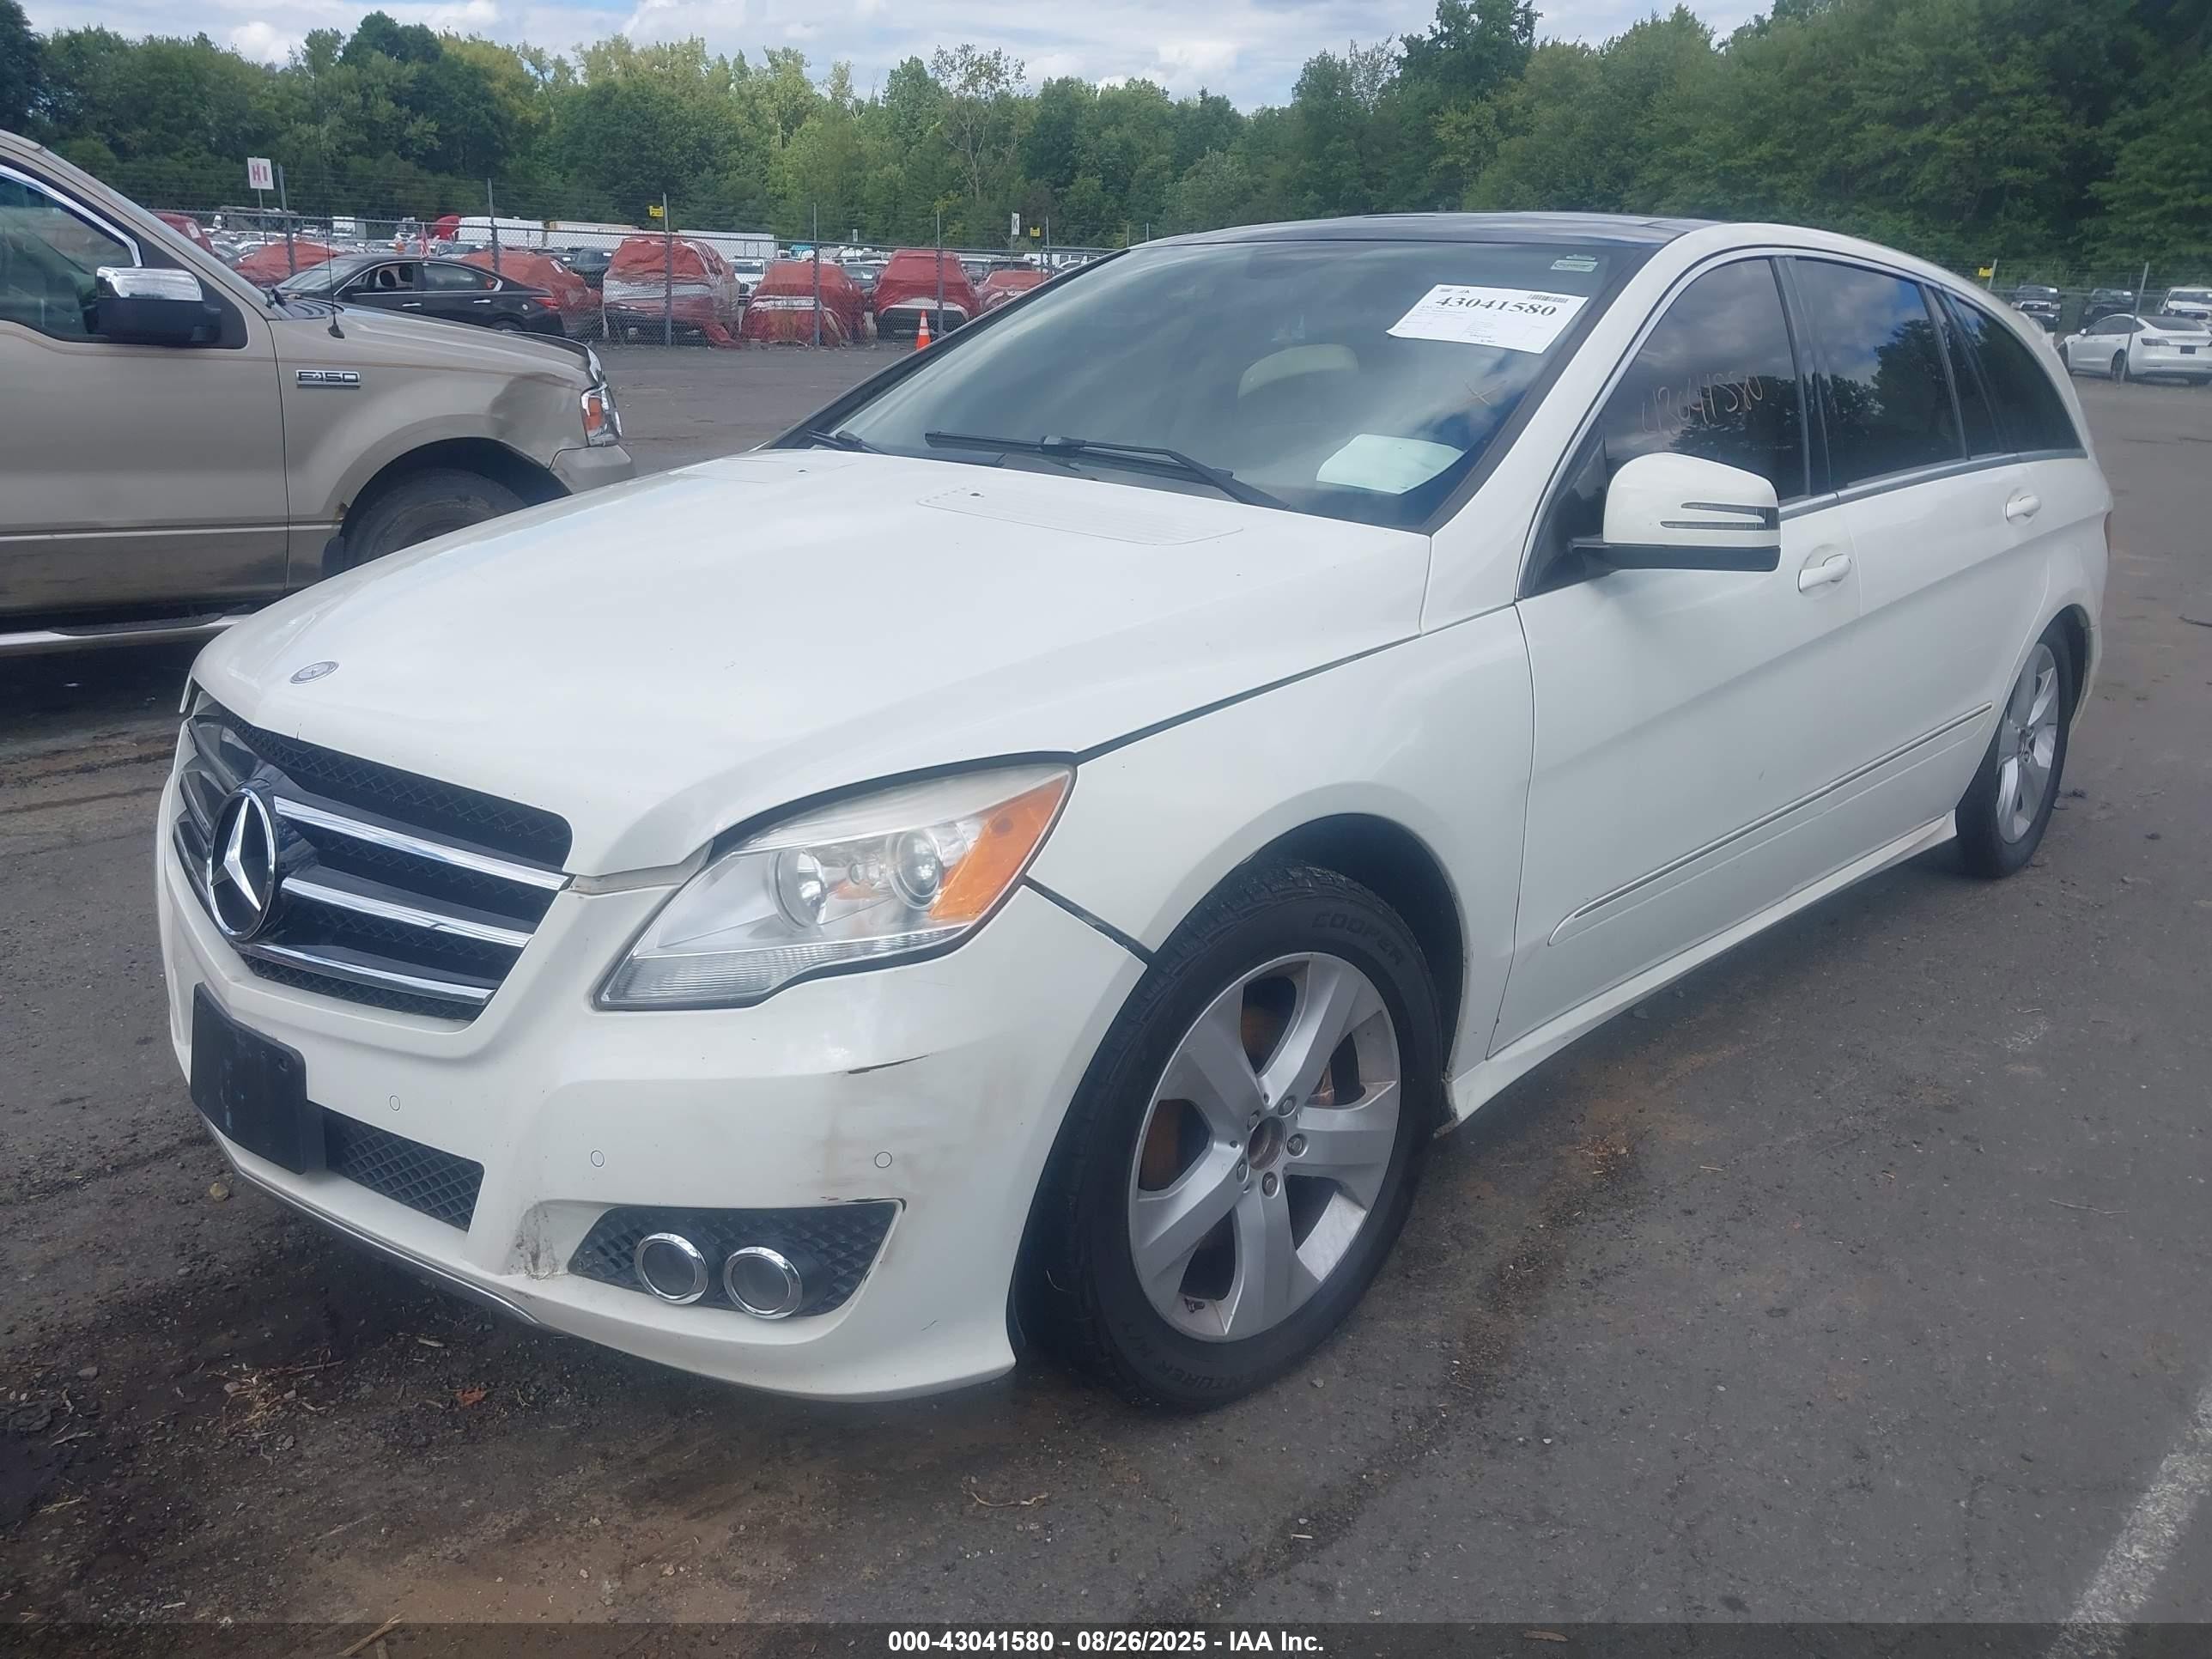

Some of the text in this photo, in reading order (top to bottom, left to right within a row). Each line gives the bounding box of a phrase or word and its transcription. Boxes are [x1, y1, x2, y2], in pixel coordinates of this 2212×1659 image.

[1435, 295, 1558, 317] 43041580
[1641, 369, 1764, 436] 43041580
[1311, 912, 1405, 966] COOPER
